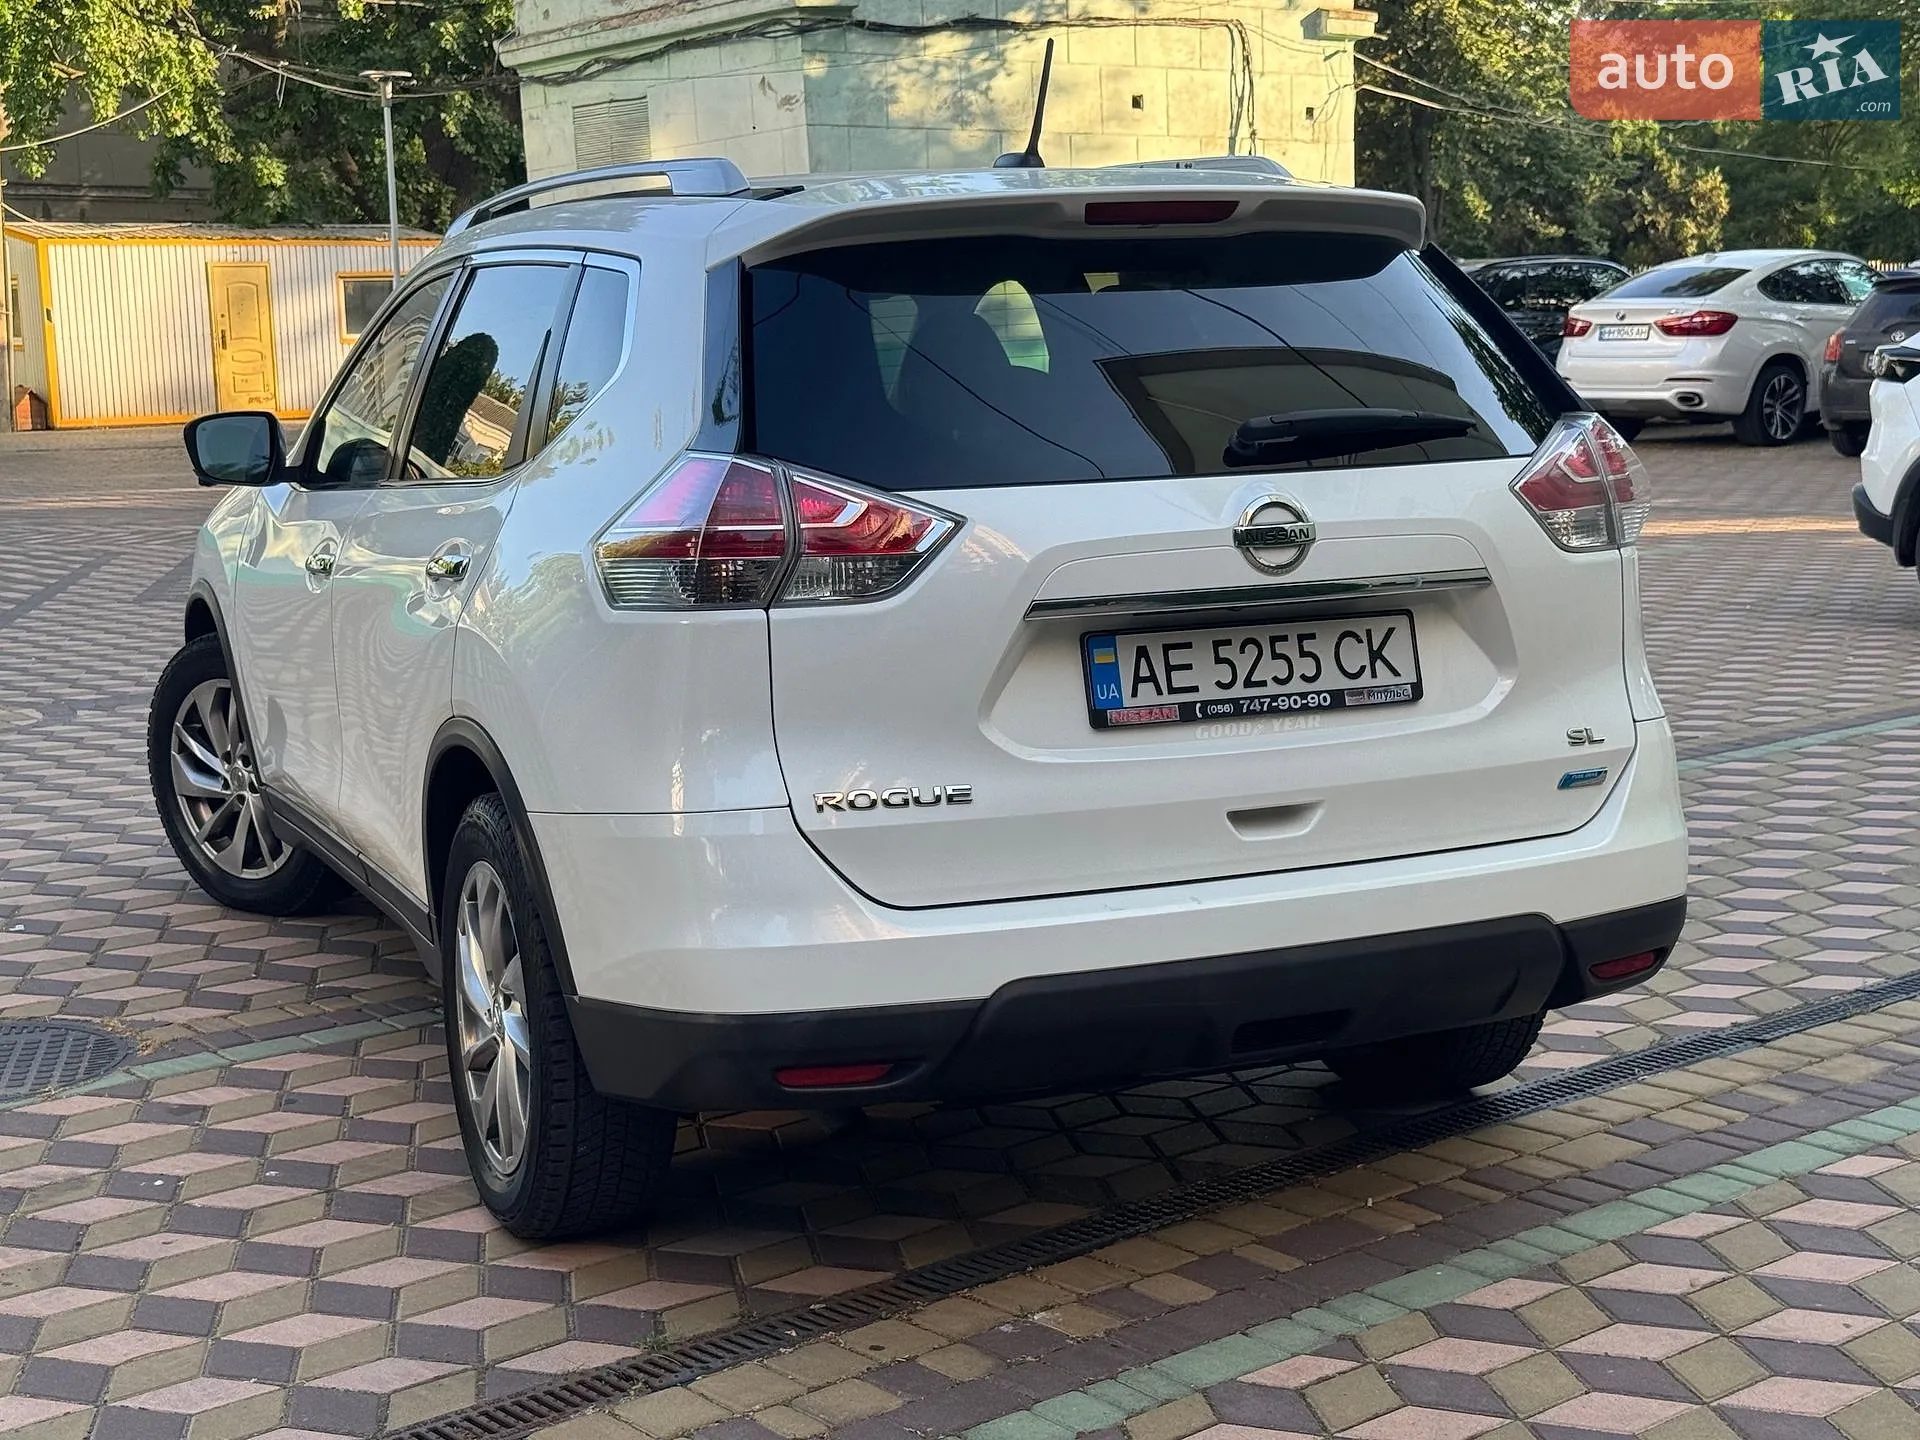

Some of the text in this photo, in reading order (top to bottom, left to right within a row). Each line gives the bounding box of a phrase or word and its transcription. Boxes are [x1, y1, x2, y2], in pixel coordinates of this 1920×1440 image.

[1244, 527, 1310, 545] NISSAN
[1130, 627, 1401, 698] AE 5255 CK
[1097, 684, 1119, 700] UA
[1239, 693, 1332, 714] 747-90-90
[1111, 706, 1178, 724] NISSAN
[1567, 727, 1606, 747] SL
[813, 784, 974, 814] ROGUE
